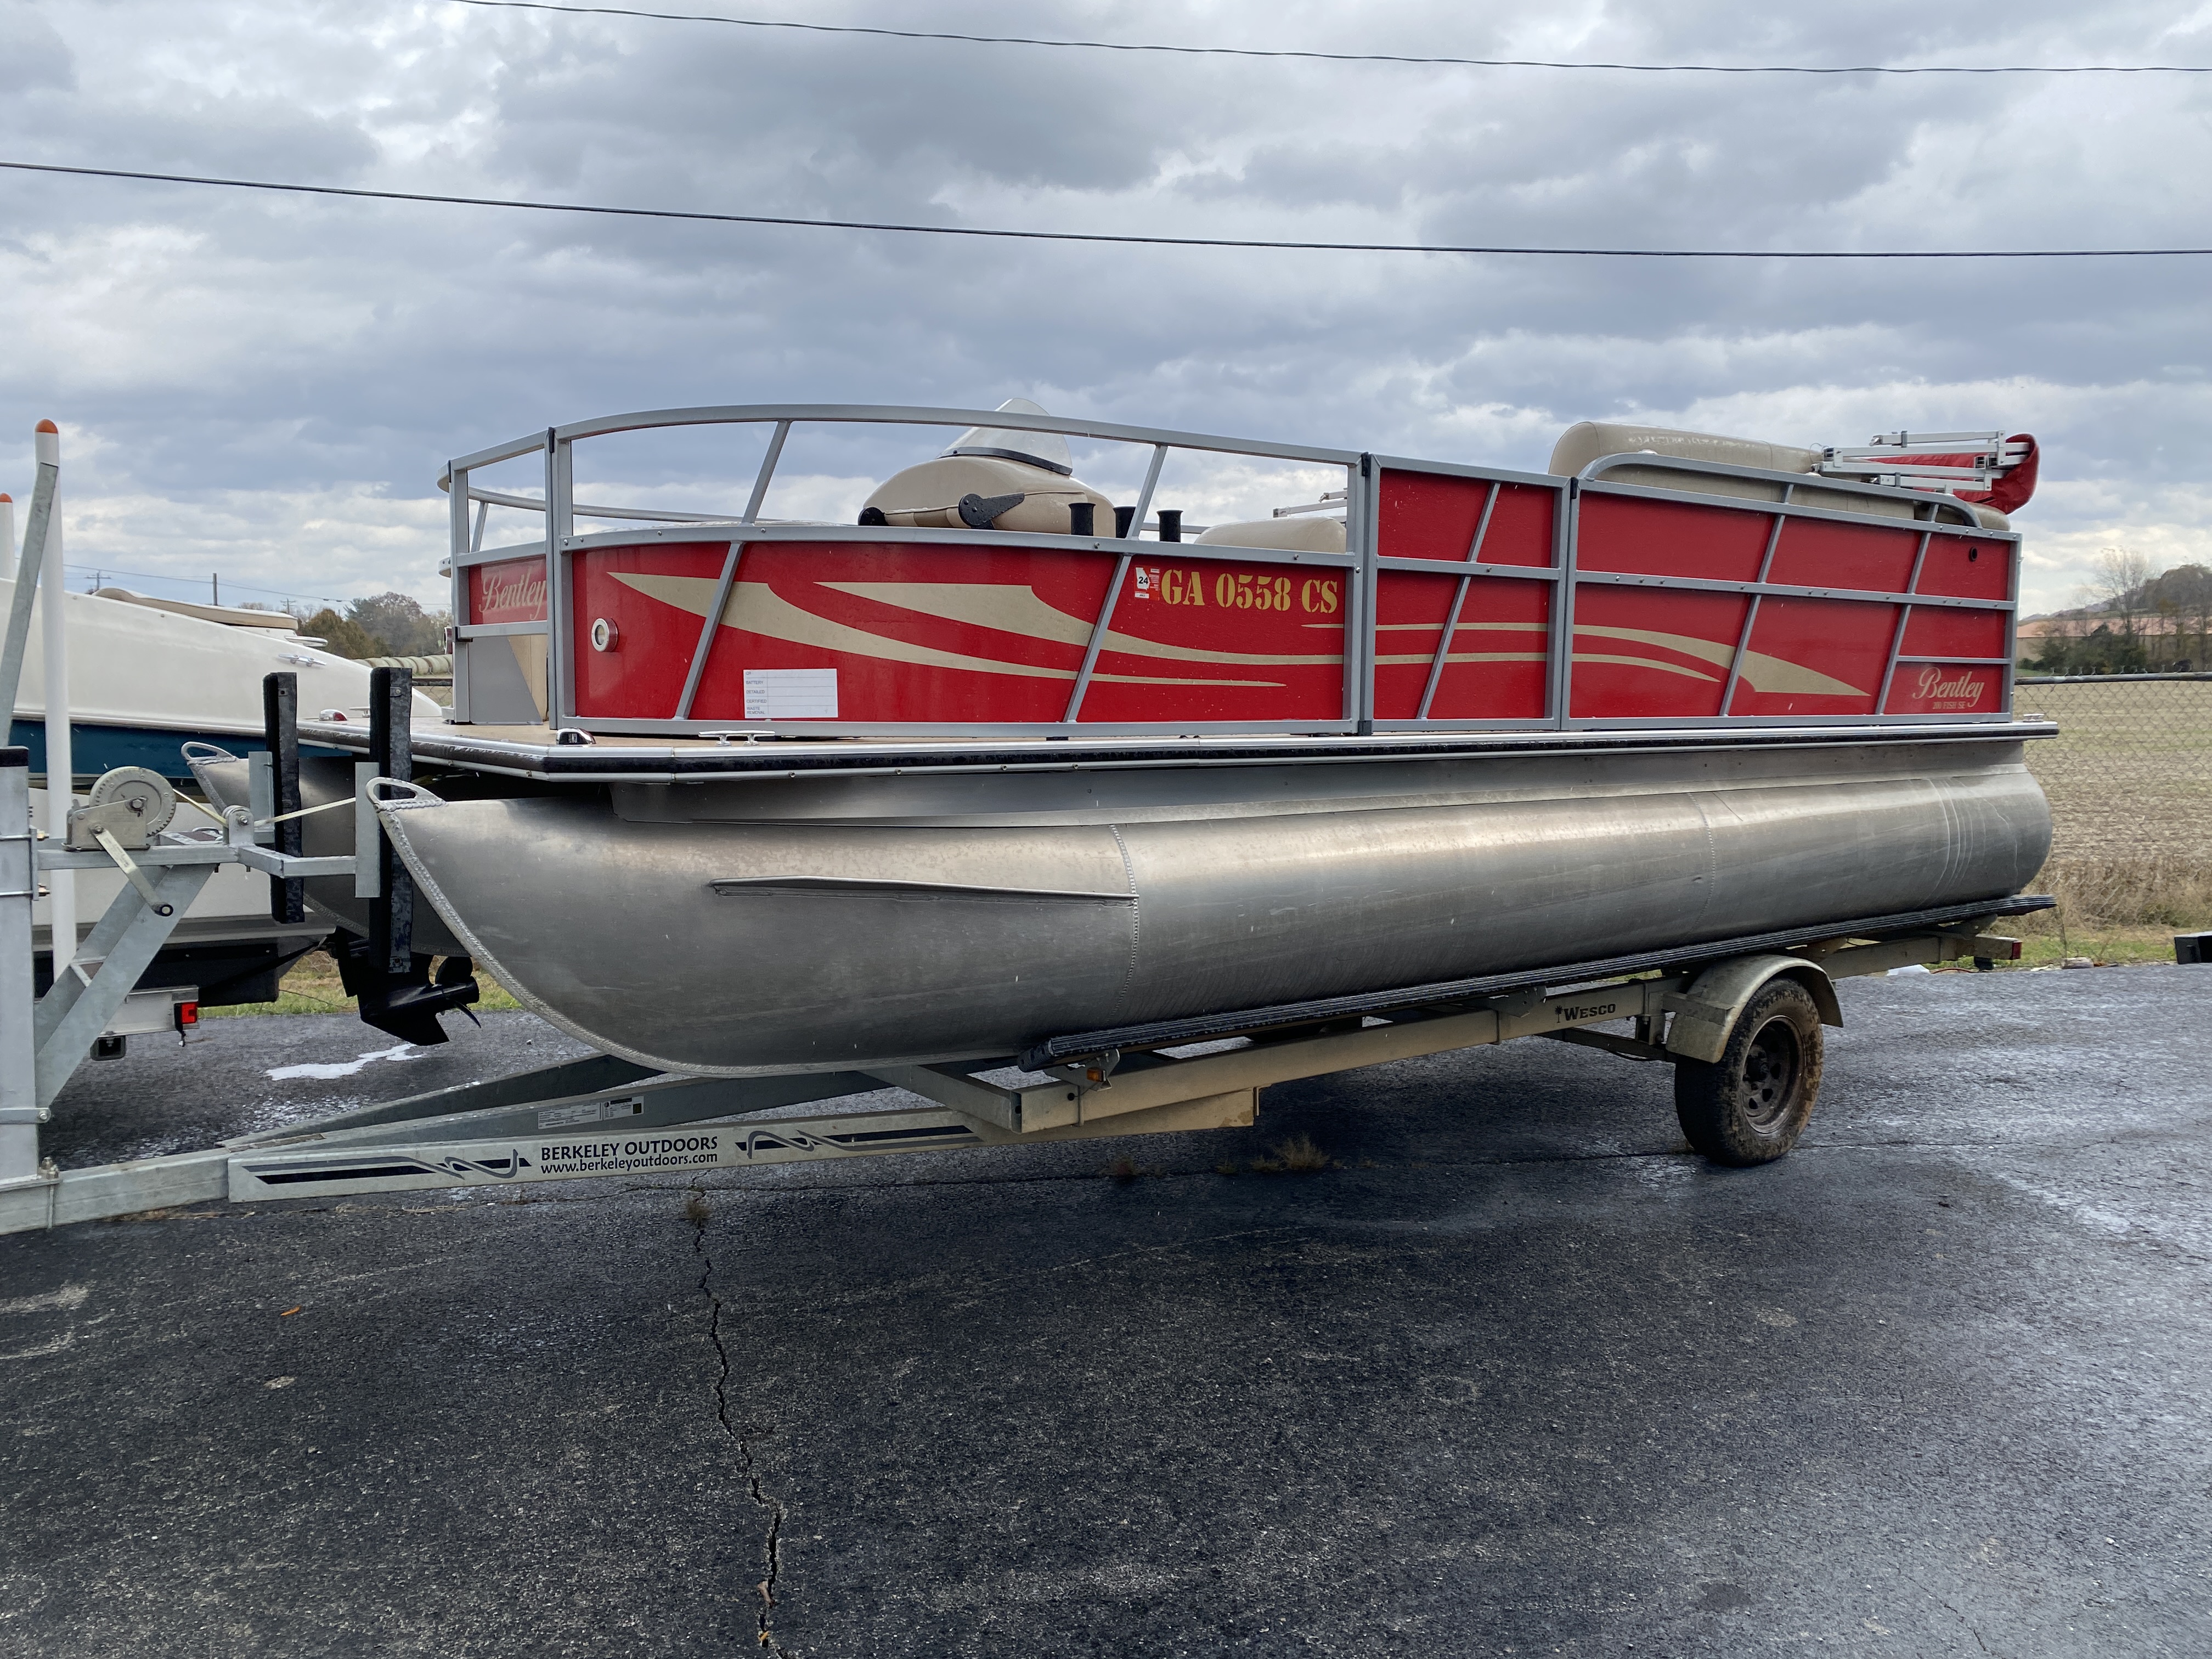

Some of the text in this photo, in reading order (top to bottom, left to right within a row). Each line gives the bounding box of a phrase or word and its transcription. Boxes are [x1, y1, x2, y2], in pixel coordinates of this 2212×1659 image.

[1138, 576, 1148, 584] 24
[1161, 569, 1205, 606] GA
[1215, 573, 1291, 611] 0558
[1301, 579, 1338, 613] CS
[478, 567, 546, 620] Bentley
[1912, 667, 1985, 708] Bentley
[1564, 1003, 1616, 1021] WESCO
[541, 1136, 718, 1161] BERKELEY OUTDOORS
[541, 1152, 718, 1175] www.berkeleyoutdoors.com
